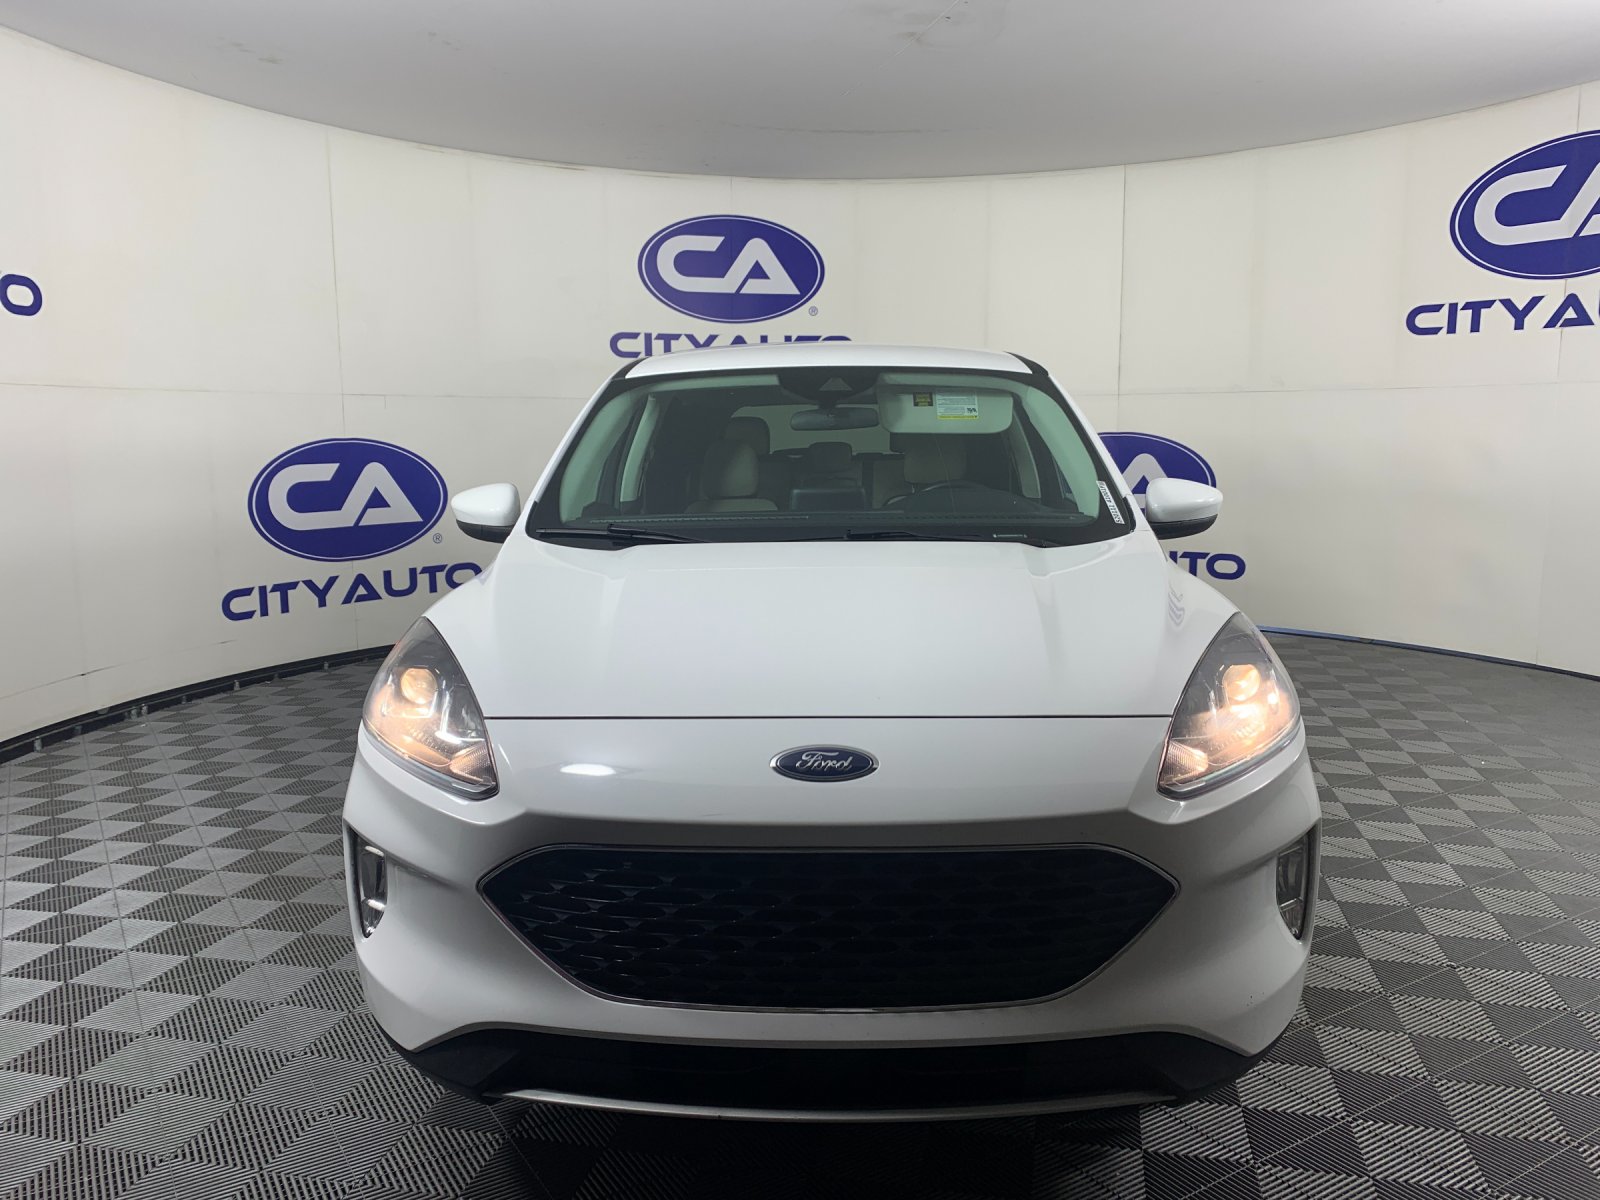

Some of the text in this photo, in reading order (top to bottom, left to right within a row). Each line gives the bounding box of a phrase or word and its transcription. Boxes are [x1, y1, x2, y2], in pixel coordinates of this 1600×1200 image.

[656, 234, 801, 295] CA
[268, 461, 424, 531] CA
[796, 750, 854, 771] Ford
